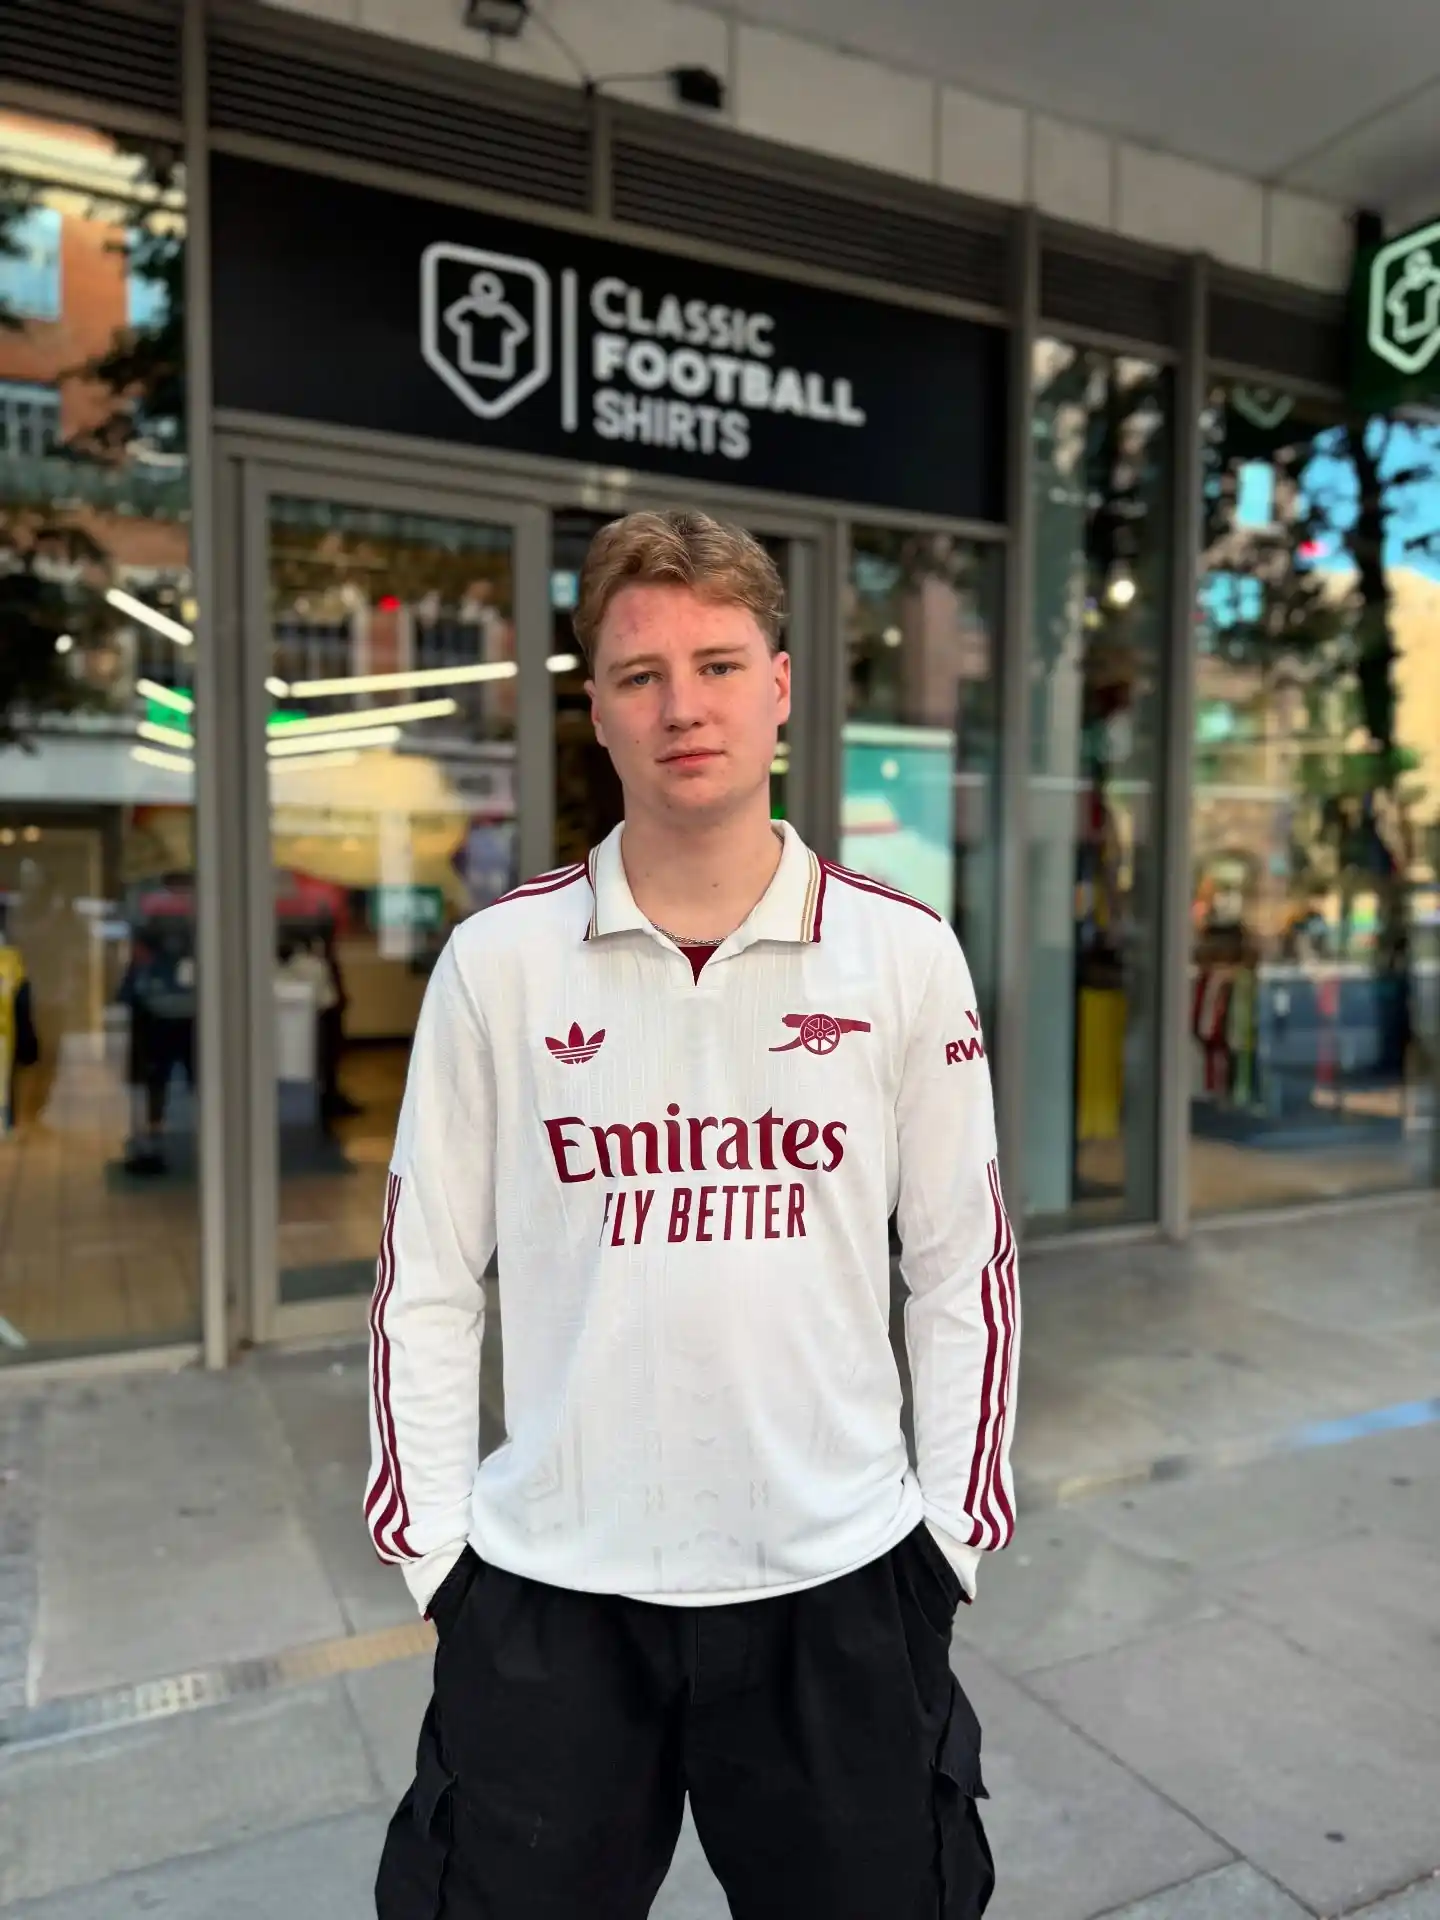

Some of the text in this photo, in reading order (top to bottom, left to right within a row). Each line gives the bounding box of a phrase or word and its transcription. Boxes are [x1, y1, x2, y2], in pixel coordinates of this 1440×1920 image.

[590, 276, 774, 357] CLASSIC
[592, 332, 866, 426] FOOTBALL
[592, 388, 751, 459] SHIRTS
[543, 1103, 847, 1183] Emirates
[667, 1182, 807, 1243] BETTER
